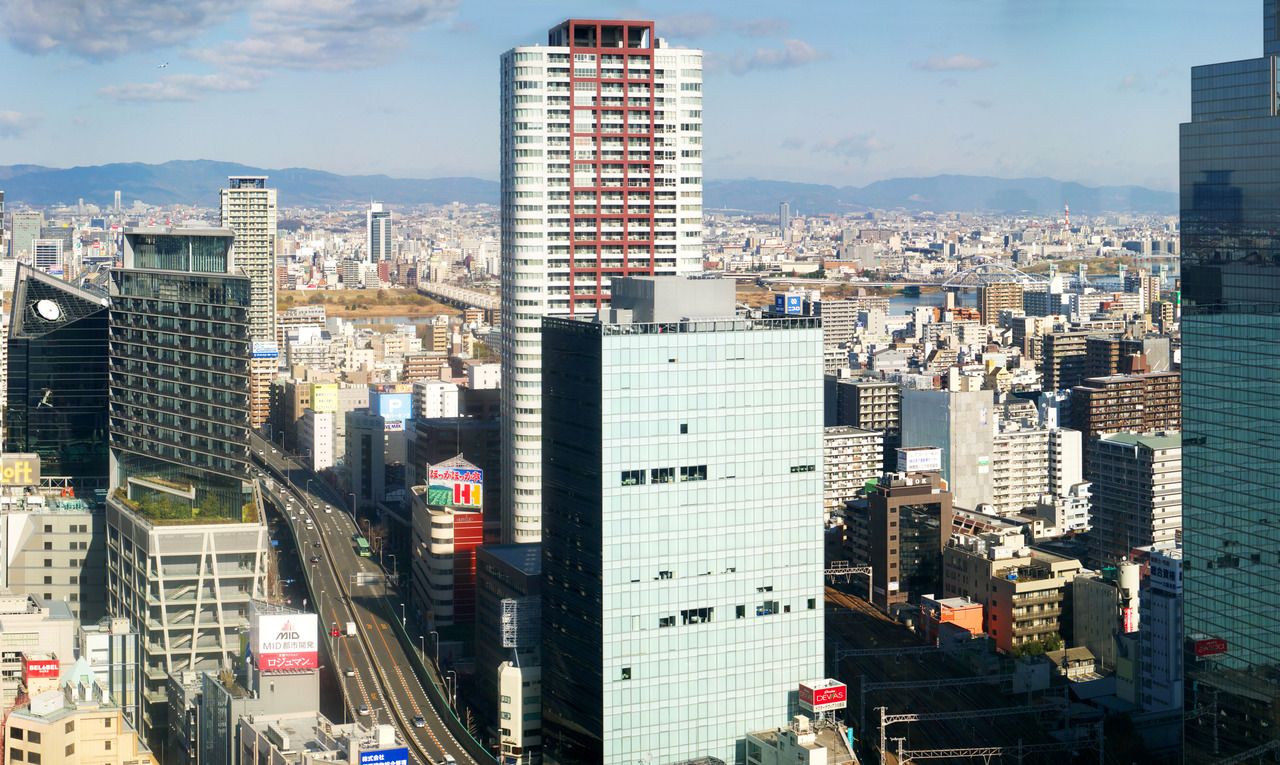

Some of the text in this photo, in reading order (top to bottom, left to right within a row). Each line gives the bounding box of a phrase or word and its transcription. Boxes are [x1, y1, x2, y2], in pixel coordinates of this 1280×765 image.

[430, 469, 481, 482] ほっかほっか亭
[275, 631, 305, 640] MID
[362, 754, 385, 762] 株式会社
